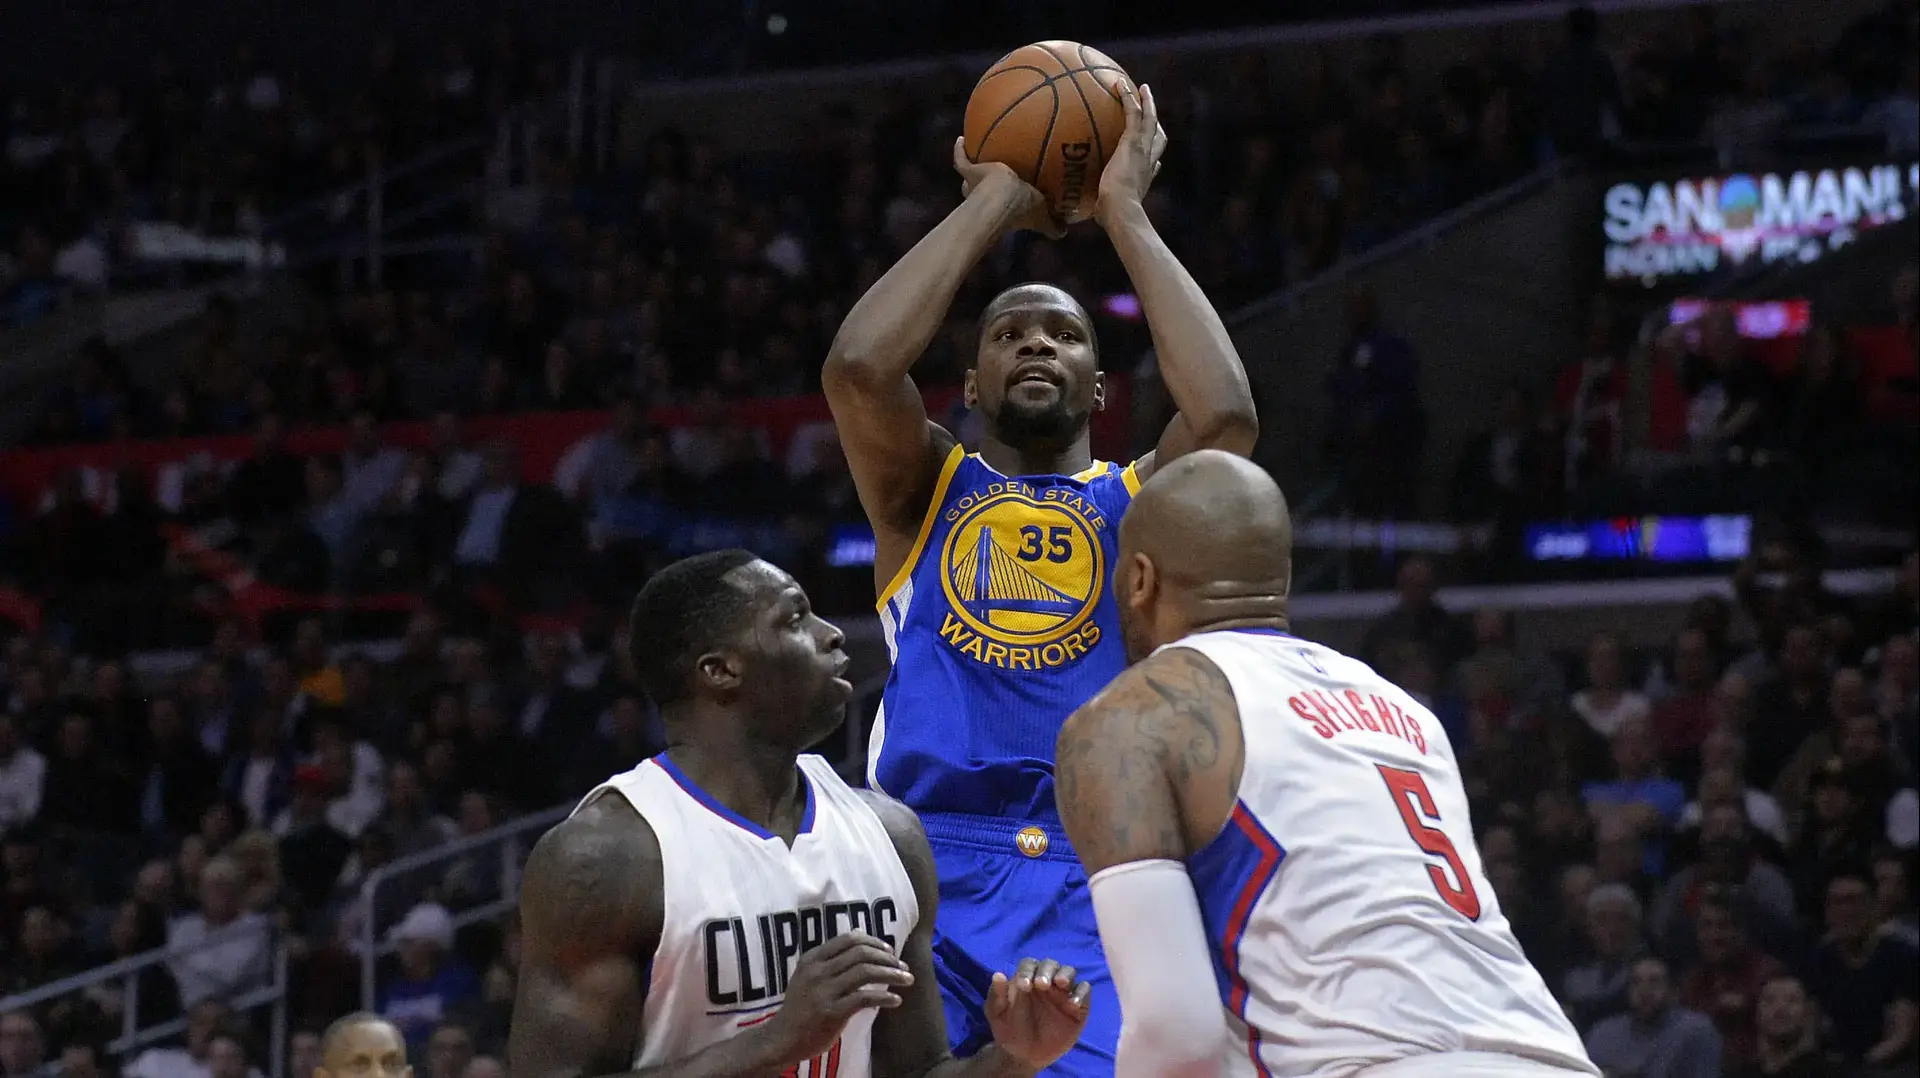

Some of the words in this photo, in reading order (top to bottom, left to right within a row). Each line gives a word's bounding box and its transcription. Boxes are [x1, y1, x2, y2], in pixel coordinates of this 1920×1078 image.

[1604, 177, 1720, 242] SAN
[944, 481, 1036, 522] GOLDEN
[1045, 489, 1107, 531] STATE
[1016, 524, 1073, 564] 35
[938, 612, 1103, 671] WARRIORS
[1019, 833, 1044, 850] W
[1373, 763, 1481, 922] 5
